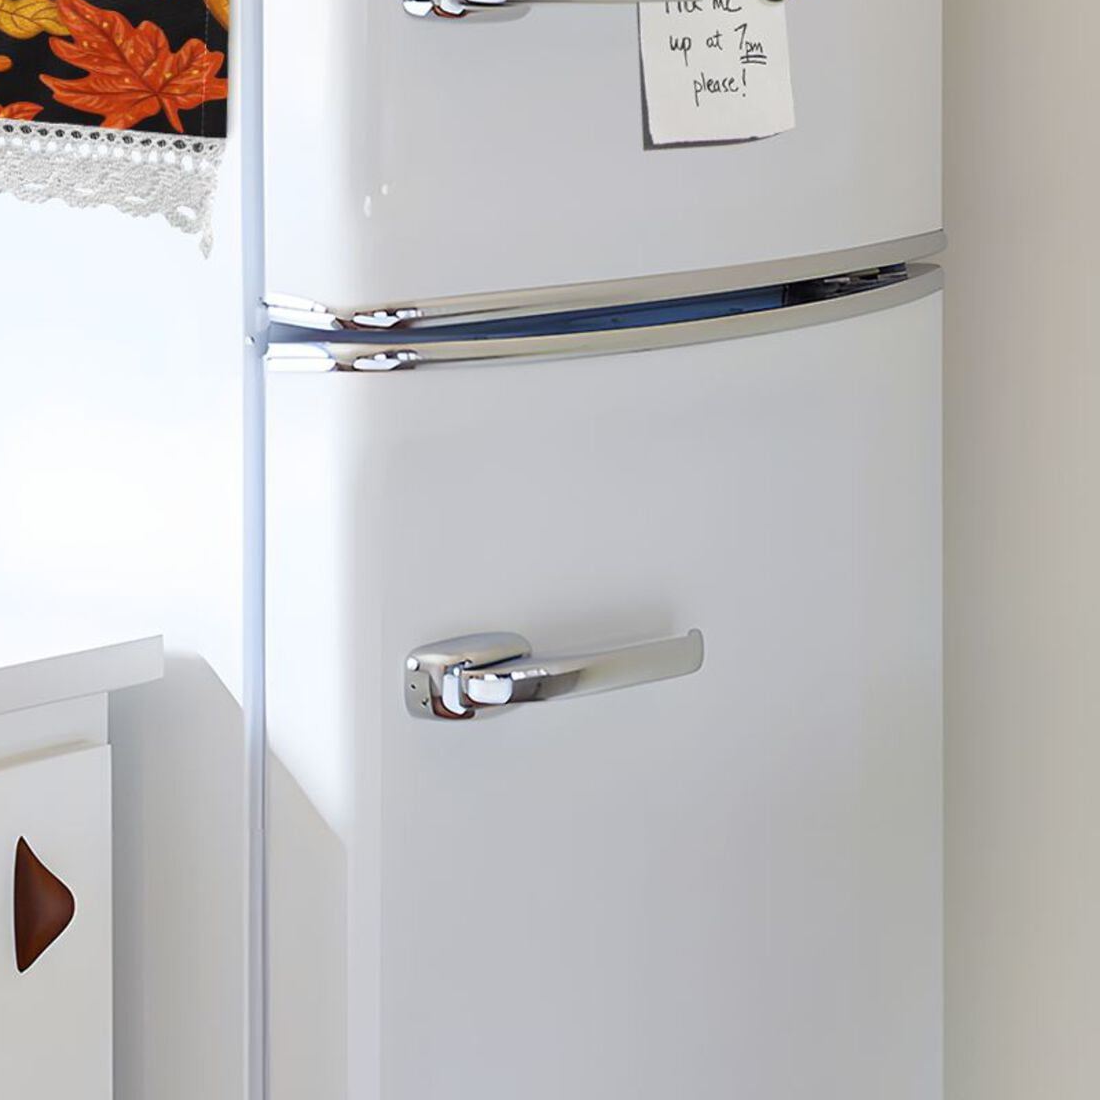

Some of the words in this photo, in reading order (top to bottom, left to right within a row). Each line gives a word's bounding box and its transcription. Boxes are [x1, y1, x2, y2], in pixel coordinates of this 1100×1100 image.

[669, 35, 692, 67] up
[706, 30, 723, 51] at
[734, 23, 764, 62] 7pm
[693, 68, 747, 107] please!
